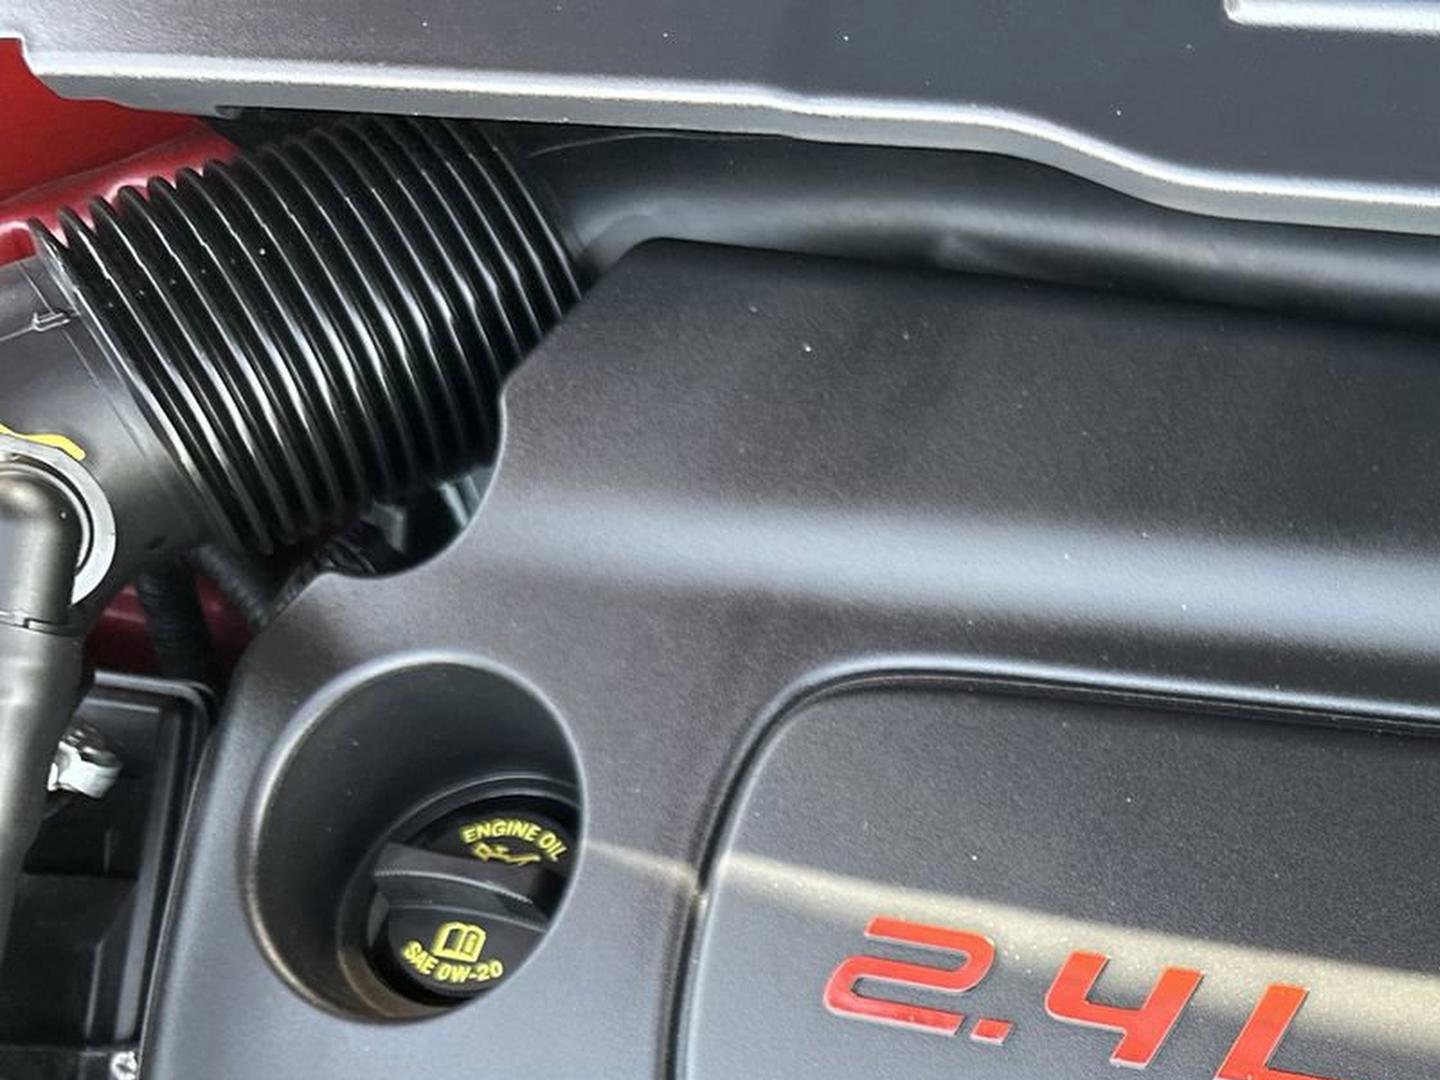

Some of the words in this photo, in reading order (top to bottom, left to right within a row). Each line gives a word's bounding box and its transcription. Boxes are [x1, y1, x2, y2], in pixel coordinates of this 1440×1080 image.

[461, 818, 542, 844] ENGINE
[538, 831, 567, 862] OIL
[402, 940, 438, 975] SAE
[436, 959, 504, 983] 0W-20
